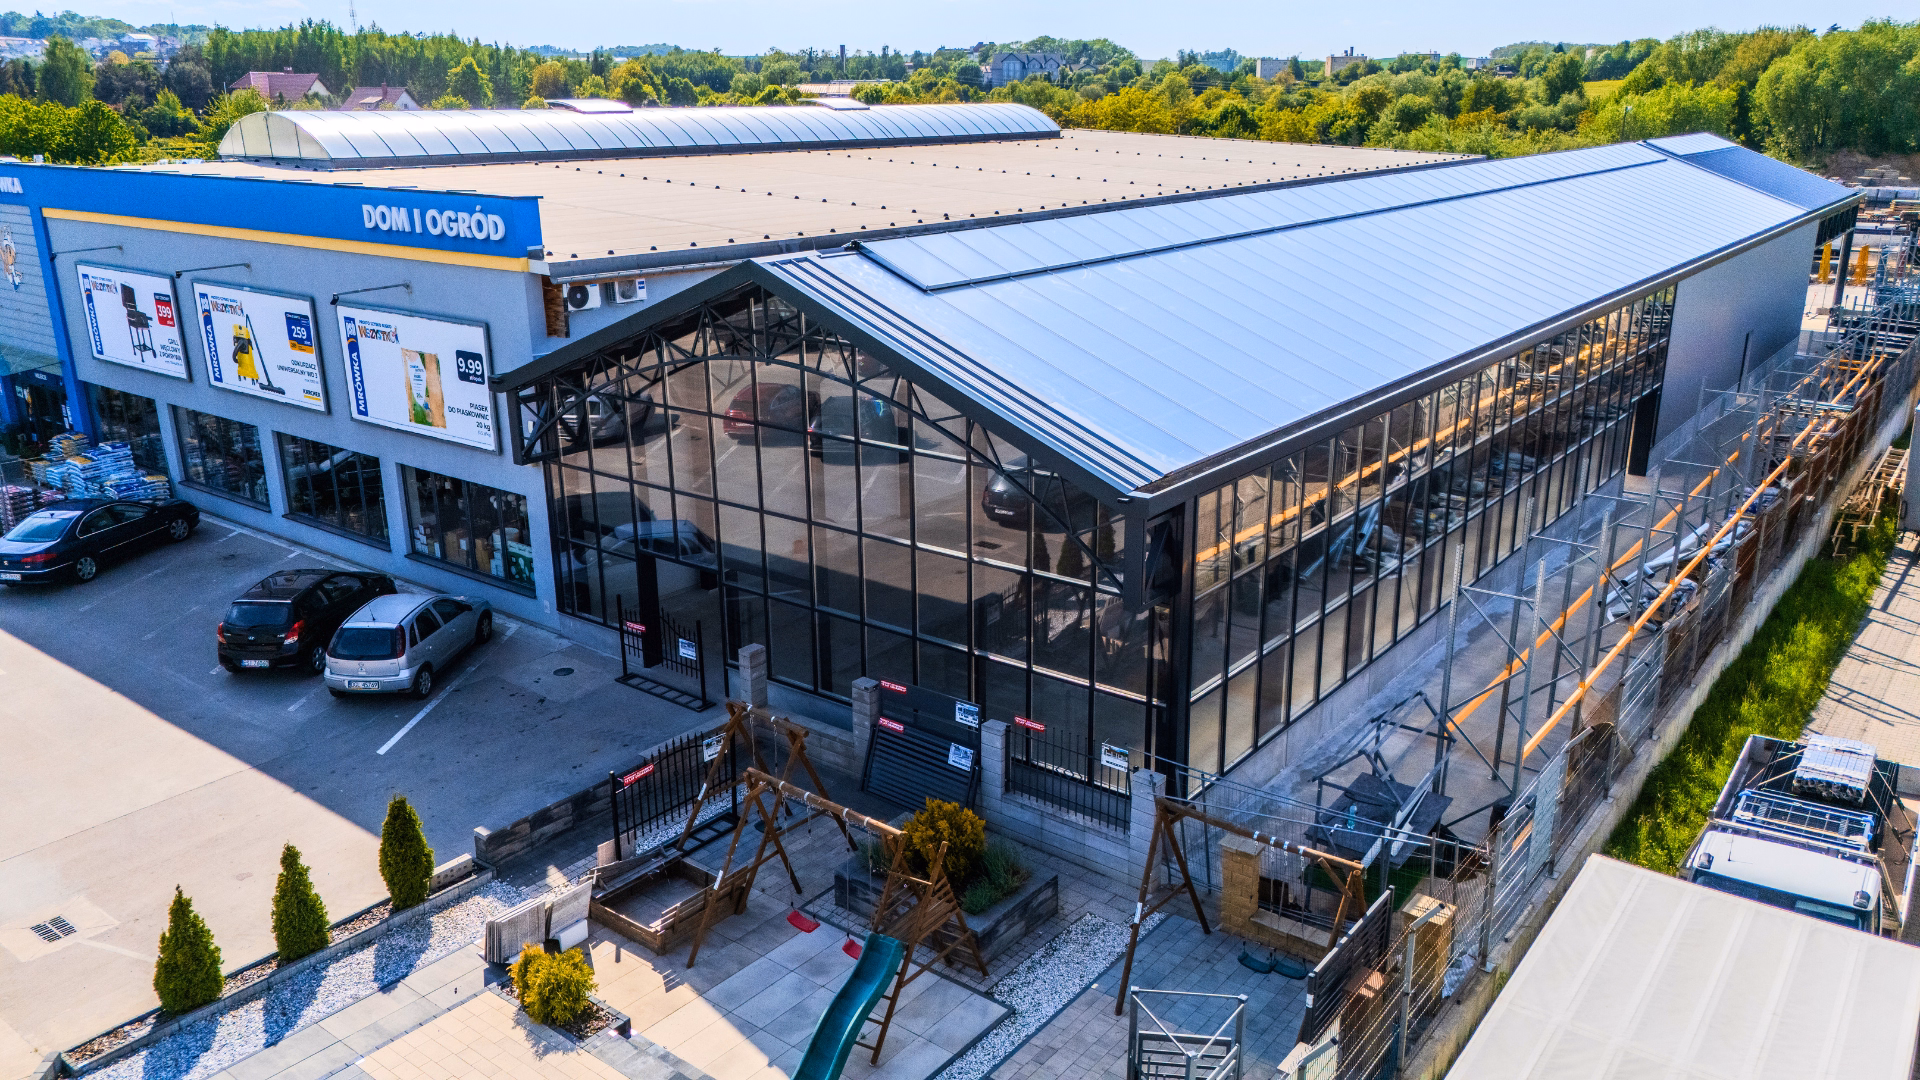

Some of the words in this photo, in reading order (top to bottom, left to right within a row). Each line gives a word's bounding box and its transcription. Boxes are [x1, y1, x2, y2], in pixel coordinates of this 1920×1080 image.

[362, 204, 411, 232] DOM
[413, 208, 423, 233] I
[425, 204, 506, 241] OGRÓD
[157, 304, 173, 319] 399
[88, 302, 102, 352] MRÓWKA
[291, 325, 307, 339] 259
[206, 324, 221, 379] MRÓWKA
[457, 357, 483, 376] 9.99
[351, 352, 366, 412] MRÓWKA
[456, 407, 490, 421] PIASKOWNIC
[469, 402, 489, 413] PIASEK
[476, 421, 484, 430] 20
[483, 423, 491, 432] kg
